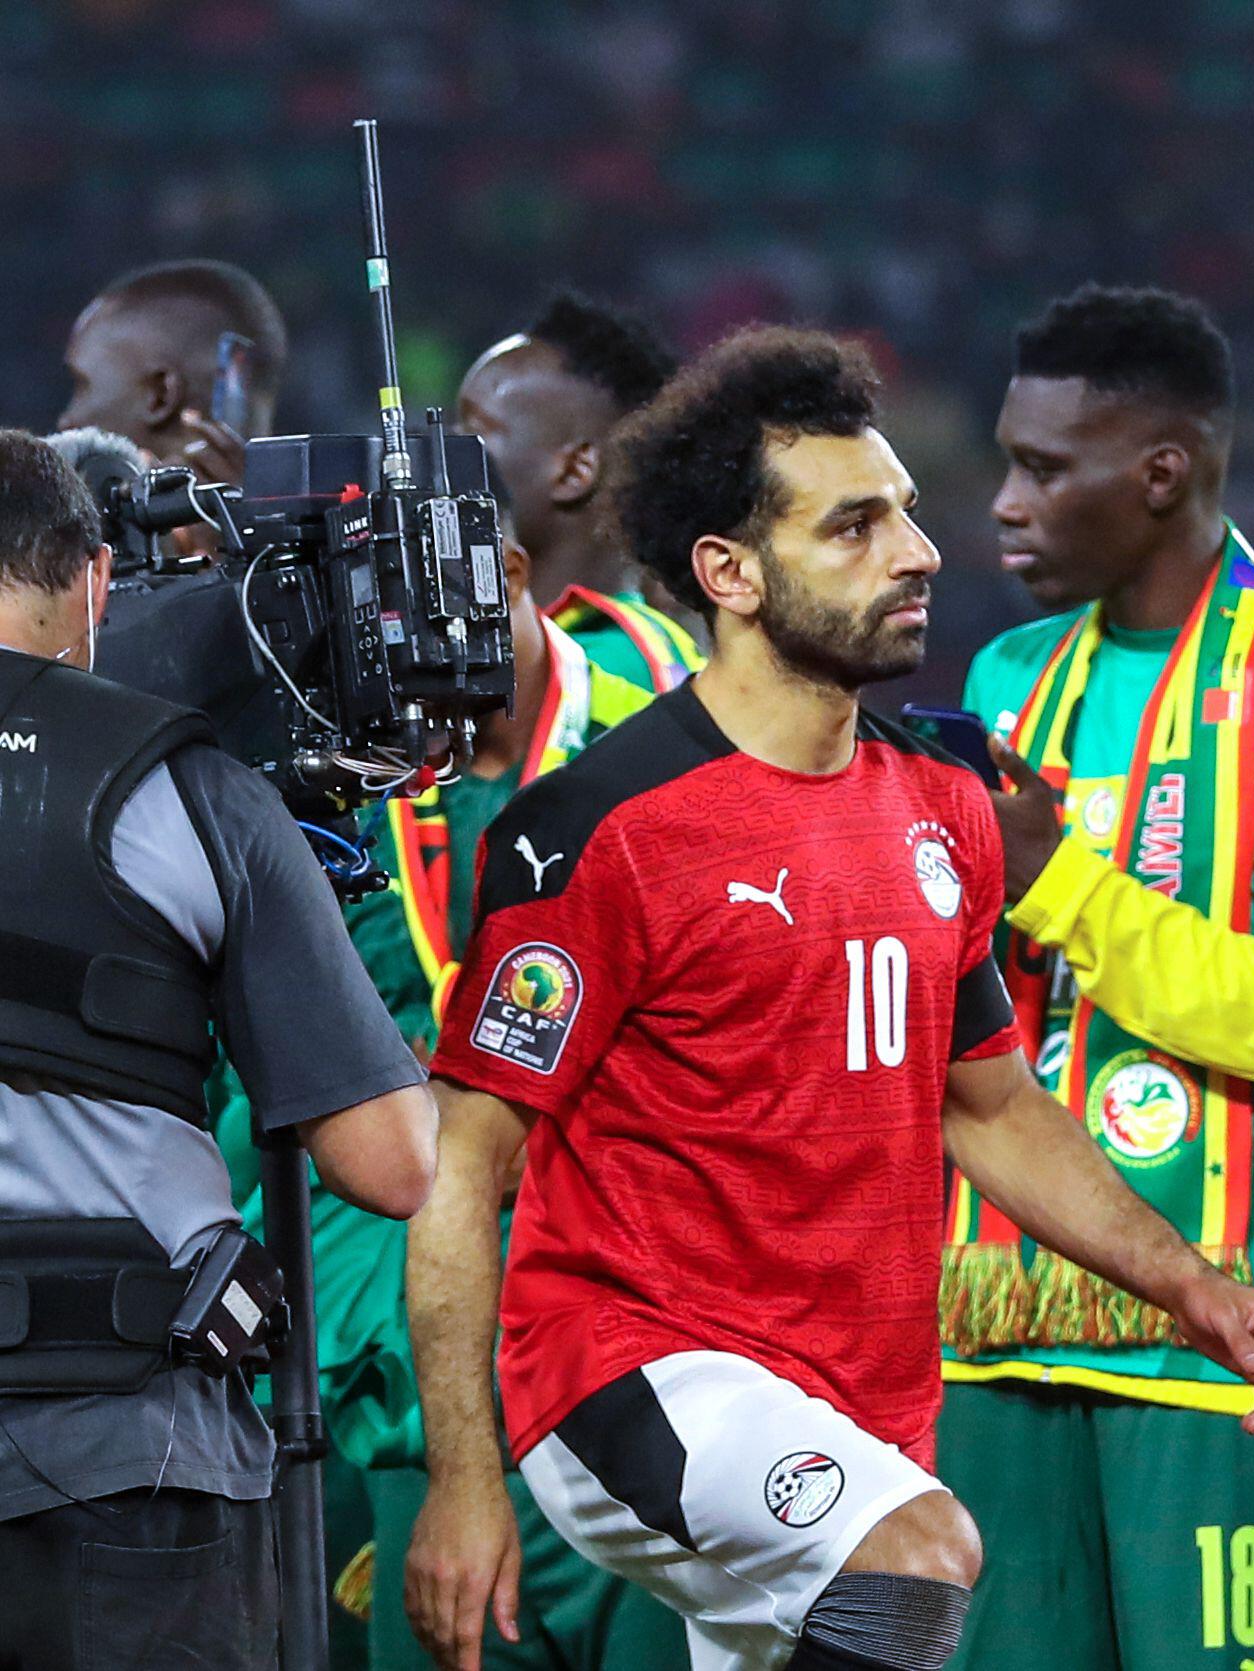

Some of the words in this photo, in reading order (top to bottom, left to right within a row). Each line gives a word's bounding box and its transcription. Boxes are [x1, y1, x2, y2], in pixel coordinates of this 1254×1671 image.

[343, 516, 368, 535] LINK
[844, 935, 909, 1072] 10
[502, 1005, 550, 1030] CAF
